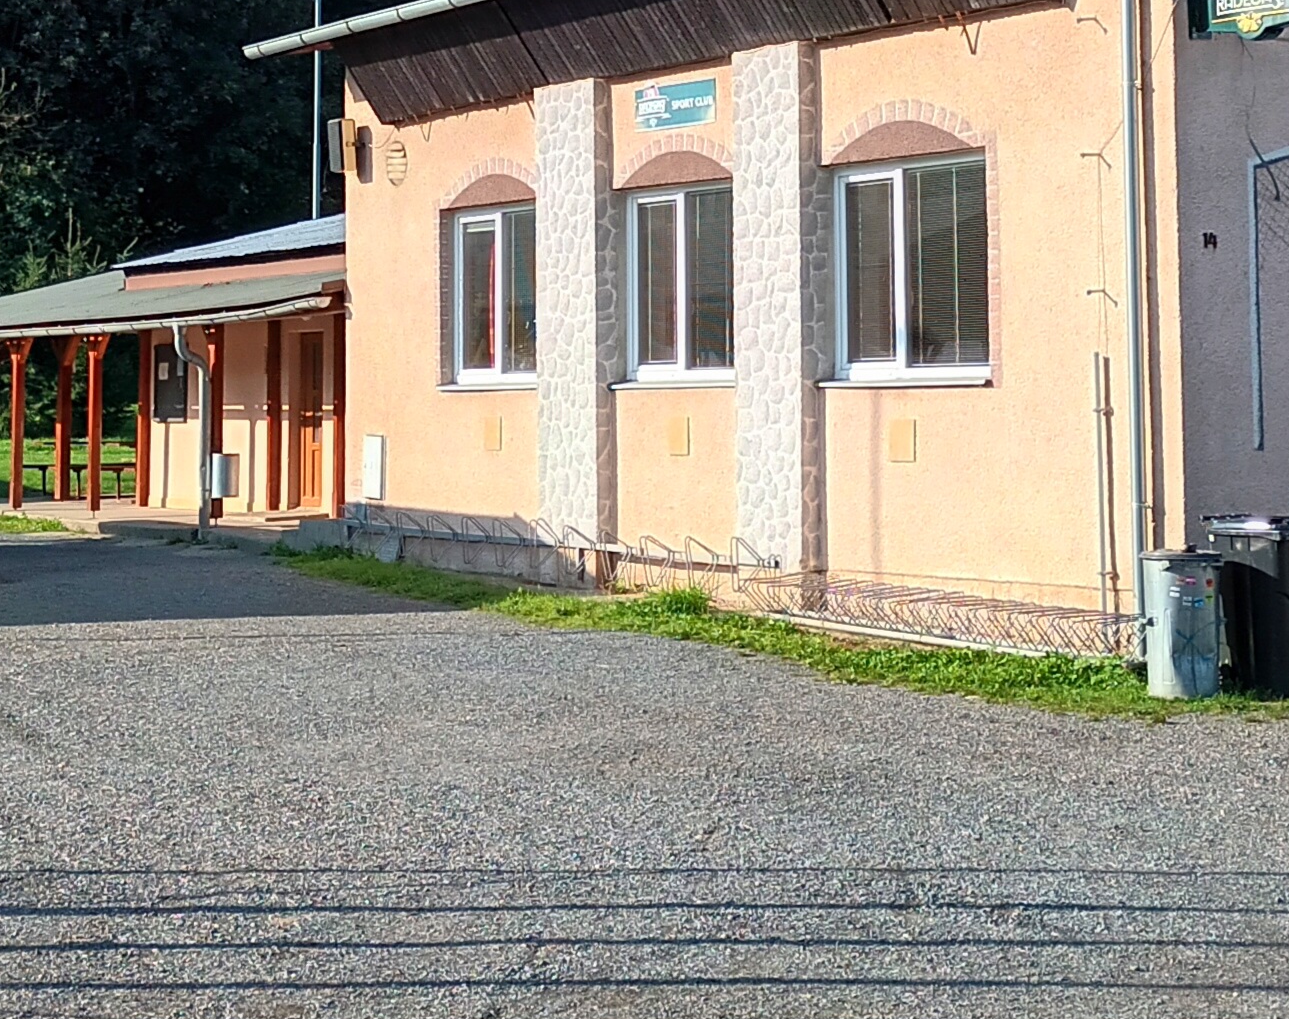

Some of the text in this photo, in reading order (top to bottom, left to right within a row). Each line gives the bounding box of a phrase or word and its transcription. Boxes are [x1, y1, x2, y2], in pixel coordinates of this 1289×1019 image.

[671, 97, 694, 111] SPORT
[695, 95, 714, 108] CLUB
[1202, 232, 1218, 250] 14
